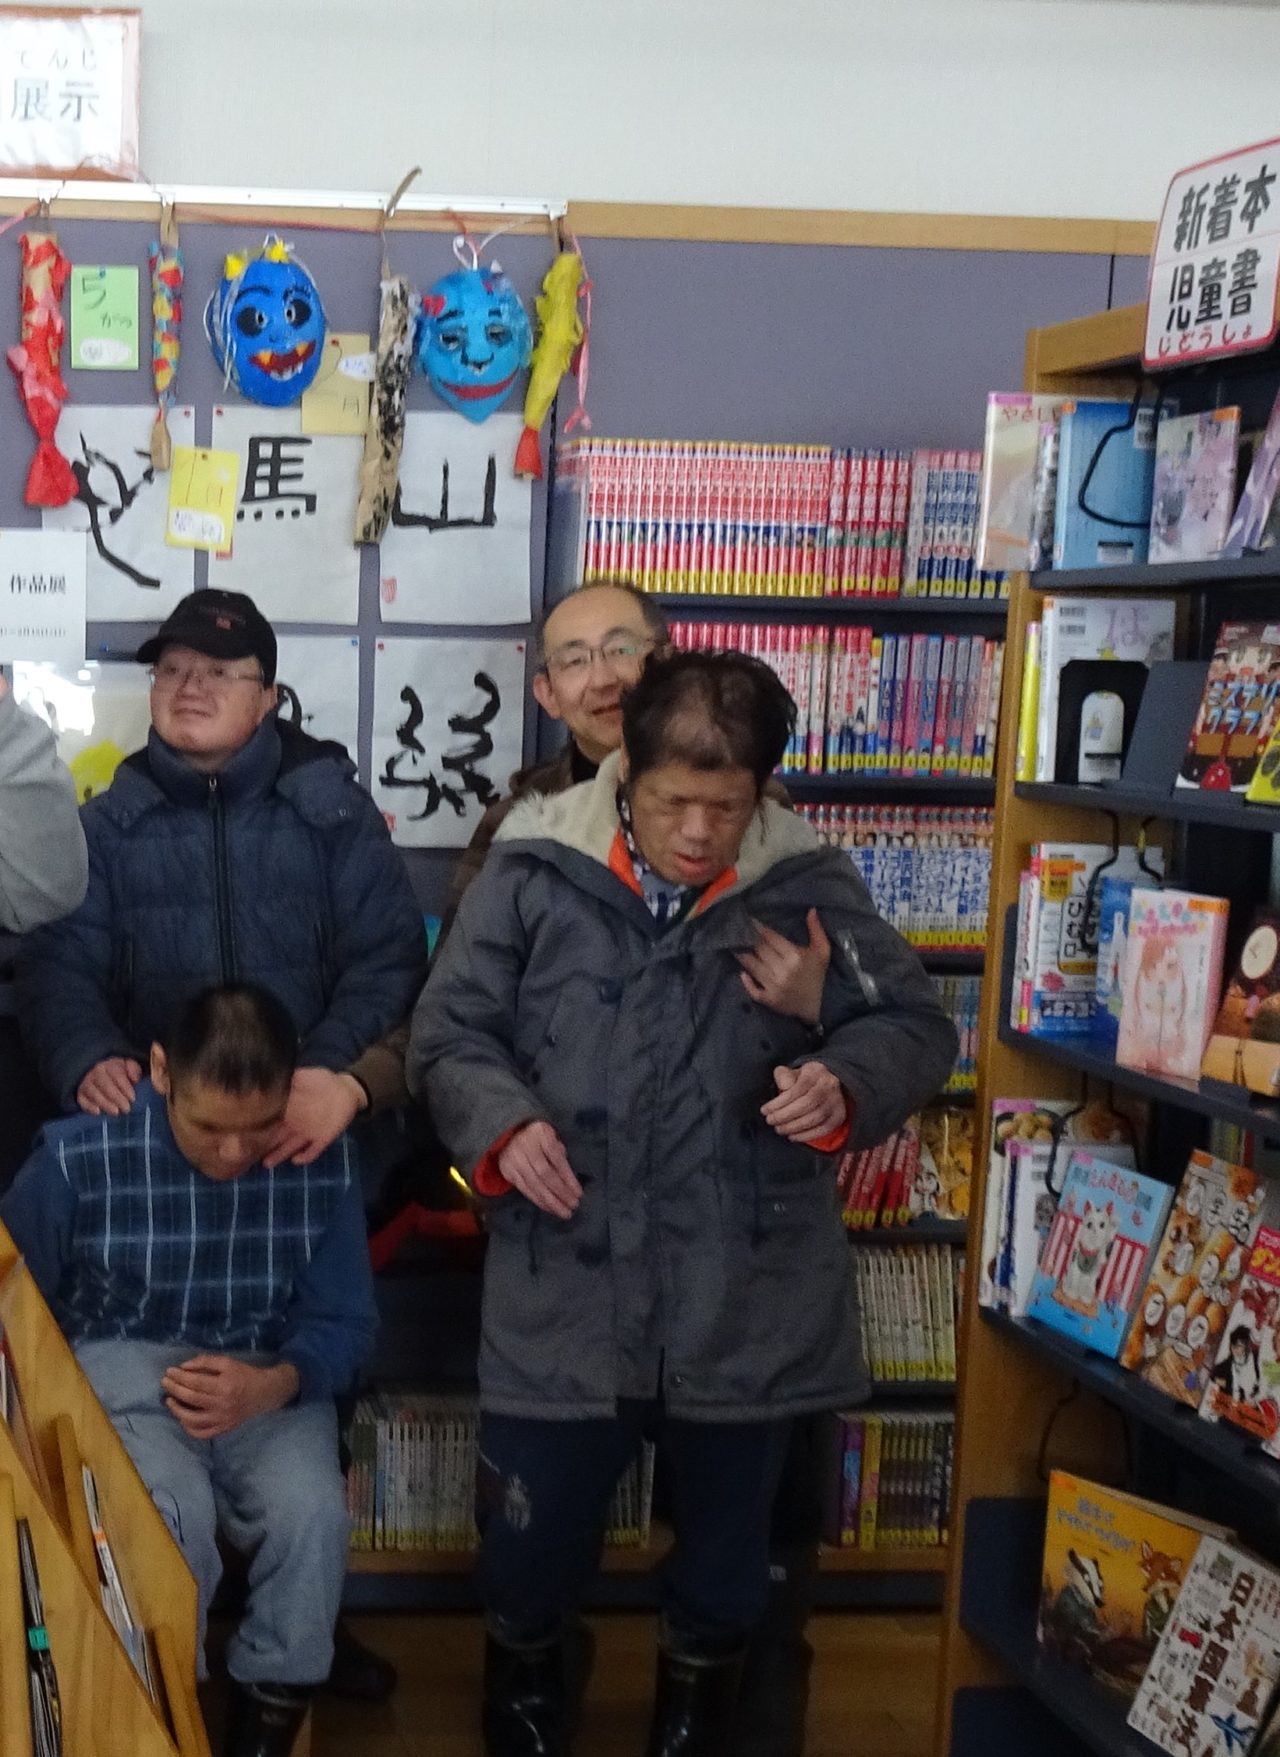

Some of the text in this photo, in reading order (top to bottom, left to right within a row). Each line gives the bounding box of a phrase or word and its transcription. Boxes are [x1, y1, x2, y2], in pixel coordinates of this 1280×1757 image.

[1174, 164, 1277, 253] 新着本
[1166, 248, 1261, 332] 児童書
[1158, 323, 1253, 357] じどうしょ
[236, 436, 317, 521] 馬
[391, 453, 497, 531] 山
[9, 572, 67, 594] 作品展
